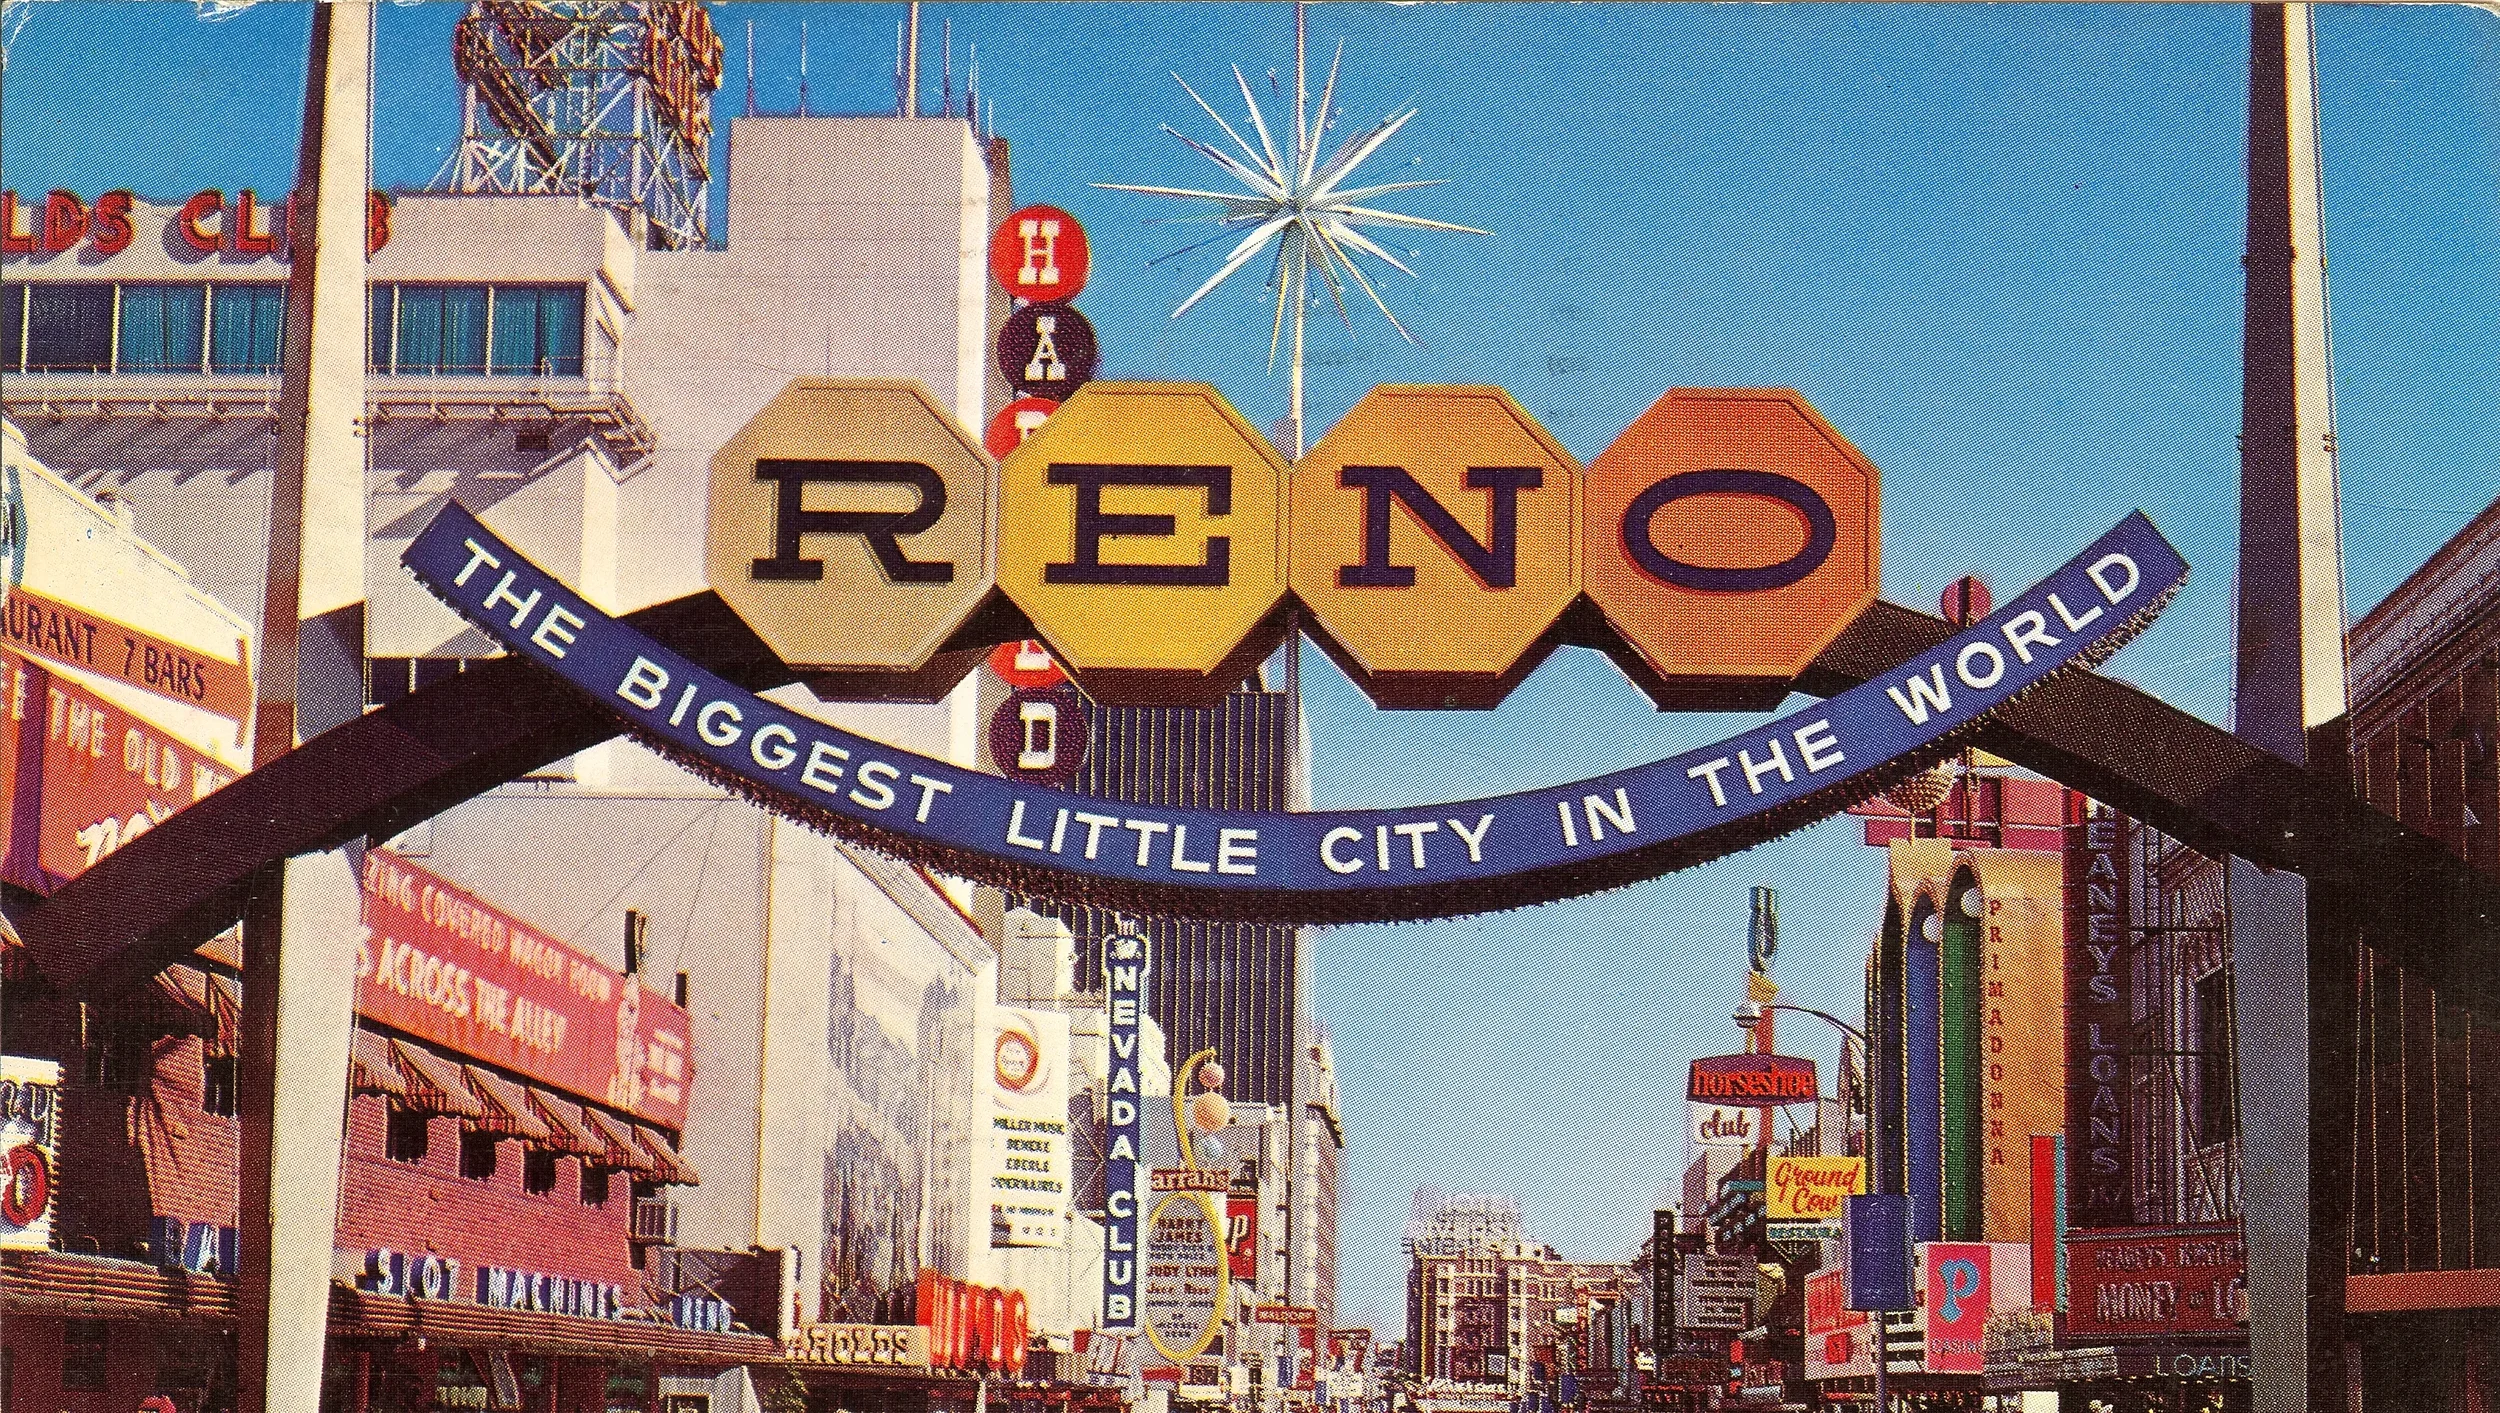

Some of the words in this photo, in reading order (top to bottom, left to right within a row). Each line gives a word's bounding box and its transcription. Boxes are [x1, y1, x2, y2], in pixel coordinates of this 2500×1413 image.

[179, 188, 394, 254] CLB
[751, 458, 1837, 594] RENO
[0, 597, 97, 664] URANT
[123, 636, 136, 678] 7
[143, 644, 206, 701] BARS
[452, 537, 586, 660] THE
[615, 654, 954, 824] BIGGEST
[1005, 800, 1260, 876] LITTLE
[1319, 813, 1495, 874] CITY
[1558, 787, 1638, 847] IN
[1686, 718, 1846, 808] THE
[1886, 551, 2143, 727] WORLD
[48, 685, 106, 759] THE
[122, 727, 182, 792] OLD
[375, 937, 471, 1019] ACROSS
[473, 975, 510, 1034] THE
[510, 995, 568, 1054] ALLEY
[1988, 899, 2004, 1166] PRIMADONNA
[1109, 965, 1140, 1162] NEVADA
[2087, 1022, 2121, 1174] LOANS
[1700, 1108, 1751, 1140] club
[1773, 1160, 1860, 1202] Ground
[1106, 1190, 1133, 1320] CLUB
[1791, 1185, 1839, 1214] Cow
